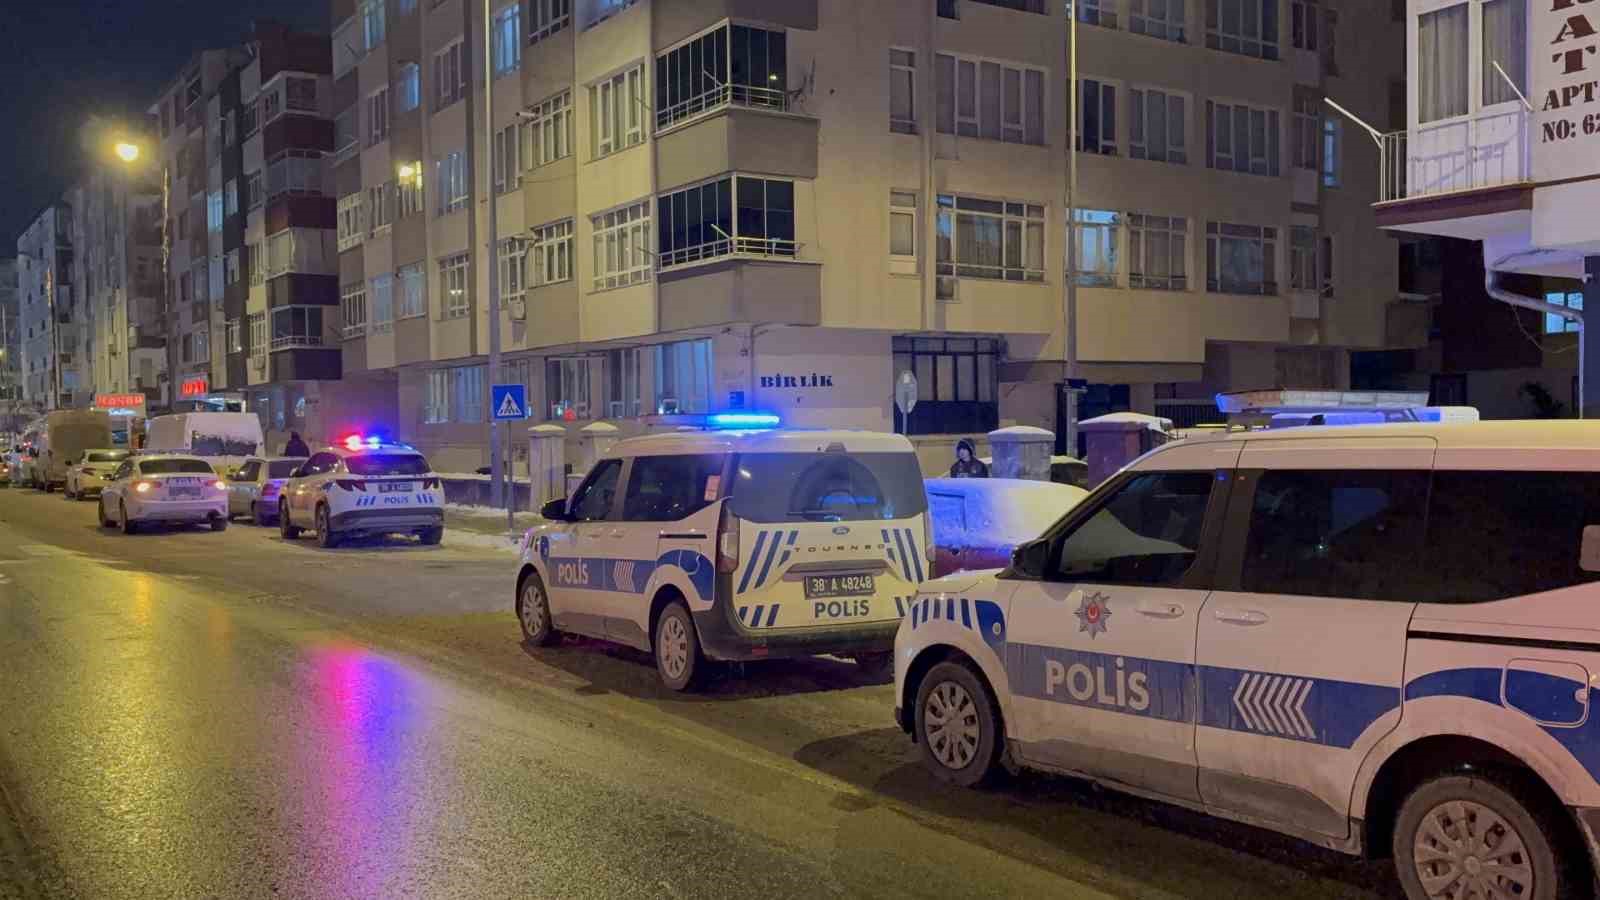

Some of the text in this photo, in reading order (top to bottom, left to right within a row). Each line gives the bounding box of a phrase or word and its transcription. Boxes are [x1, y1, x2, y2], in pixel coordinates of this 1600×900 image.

[1542, 81, 1598, 111] APT
[1542, 119, 1576, 143] NO:
[760, 373, 833, 388] BİRLİK
[812, 577, 825, 591] 38
[831, 577, 838, 590] A
